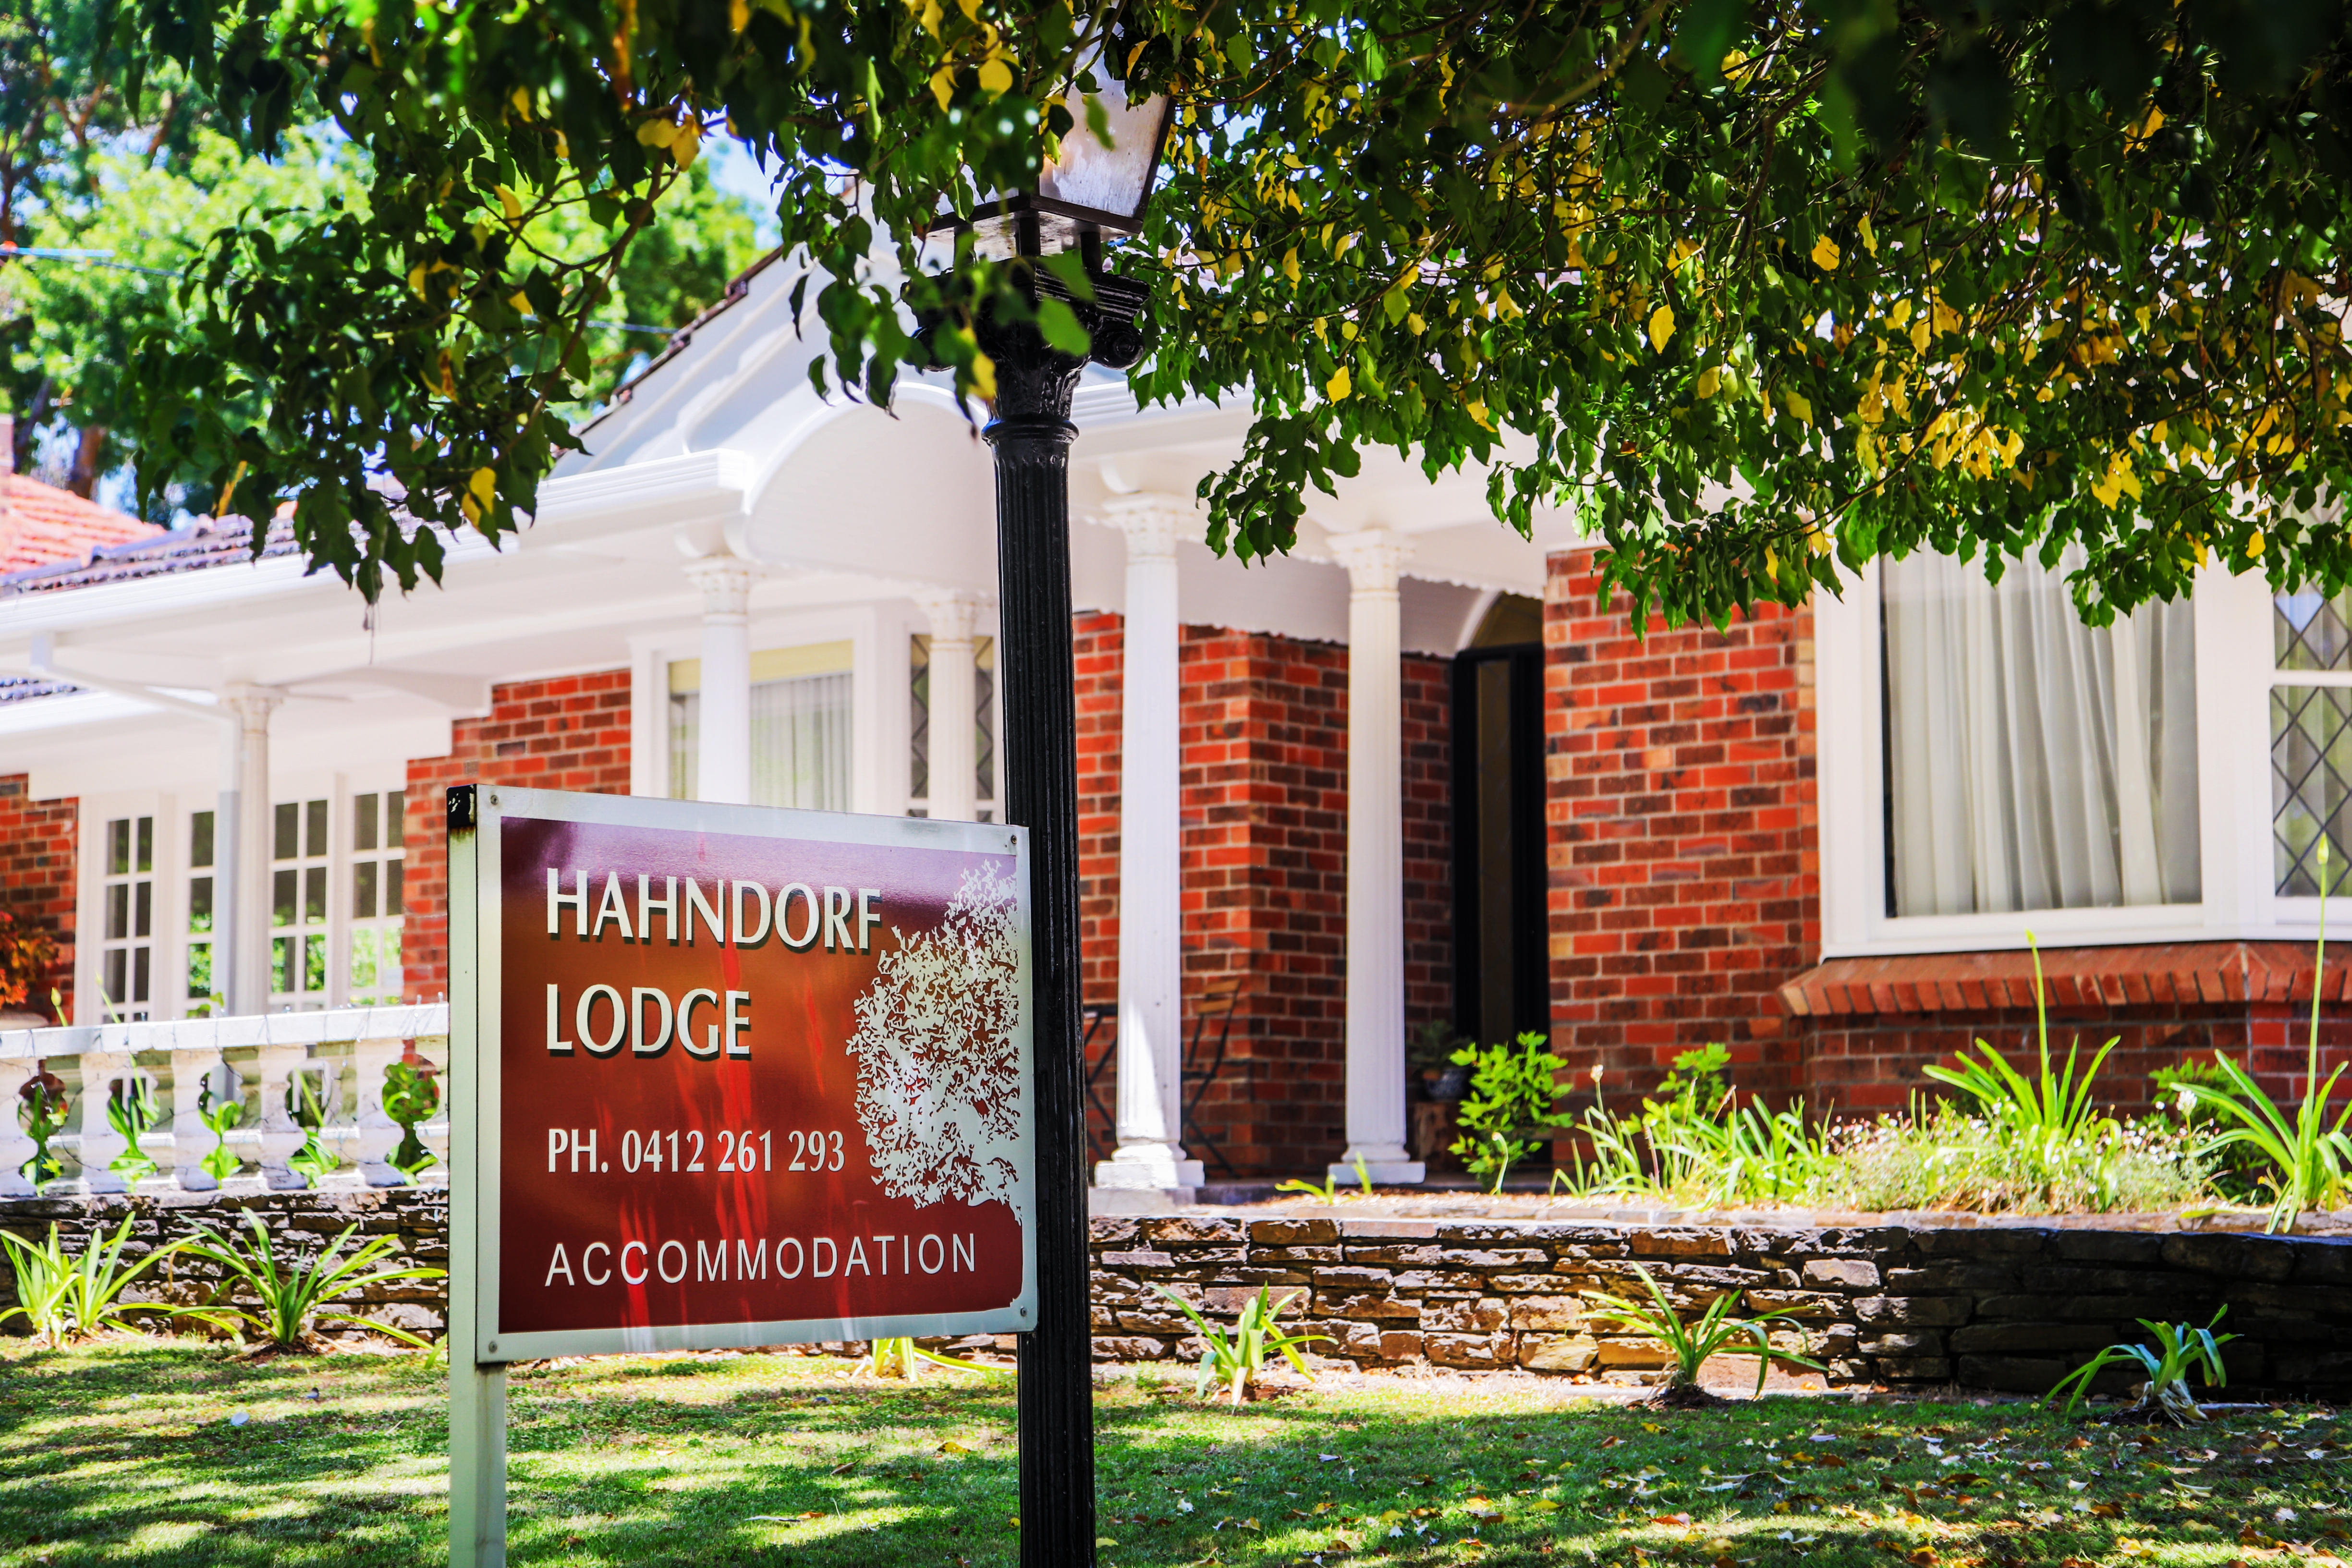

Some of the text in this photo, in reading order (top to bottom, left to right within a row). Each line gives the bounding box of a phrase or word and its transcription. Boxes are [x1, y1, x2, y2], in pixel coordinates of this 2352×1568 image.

[547, 868, 881, 949] HAHNDORF
[547, 984, 751, 1055] LODGE
[548, 1129, 845, 1173] PH. 0412 261 293
[544, 1233, 975, 1287] ACCOMMODATION
